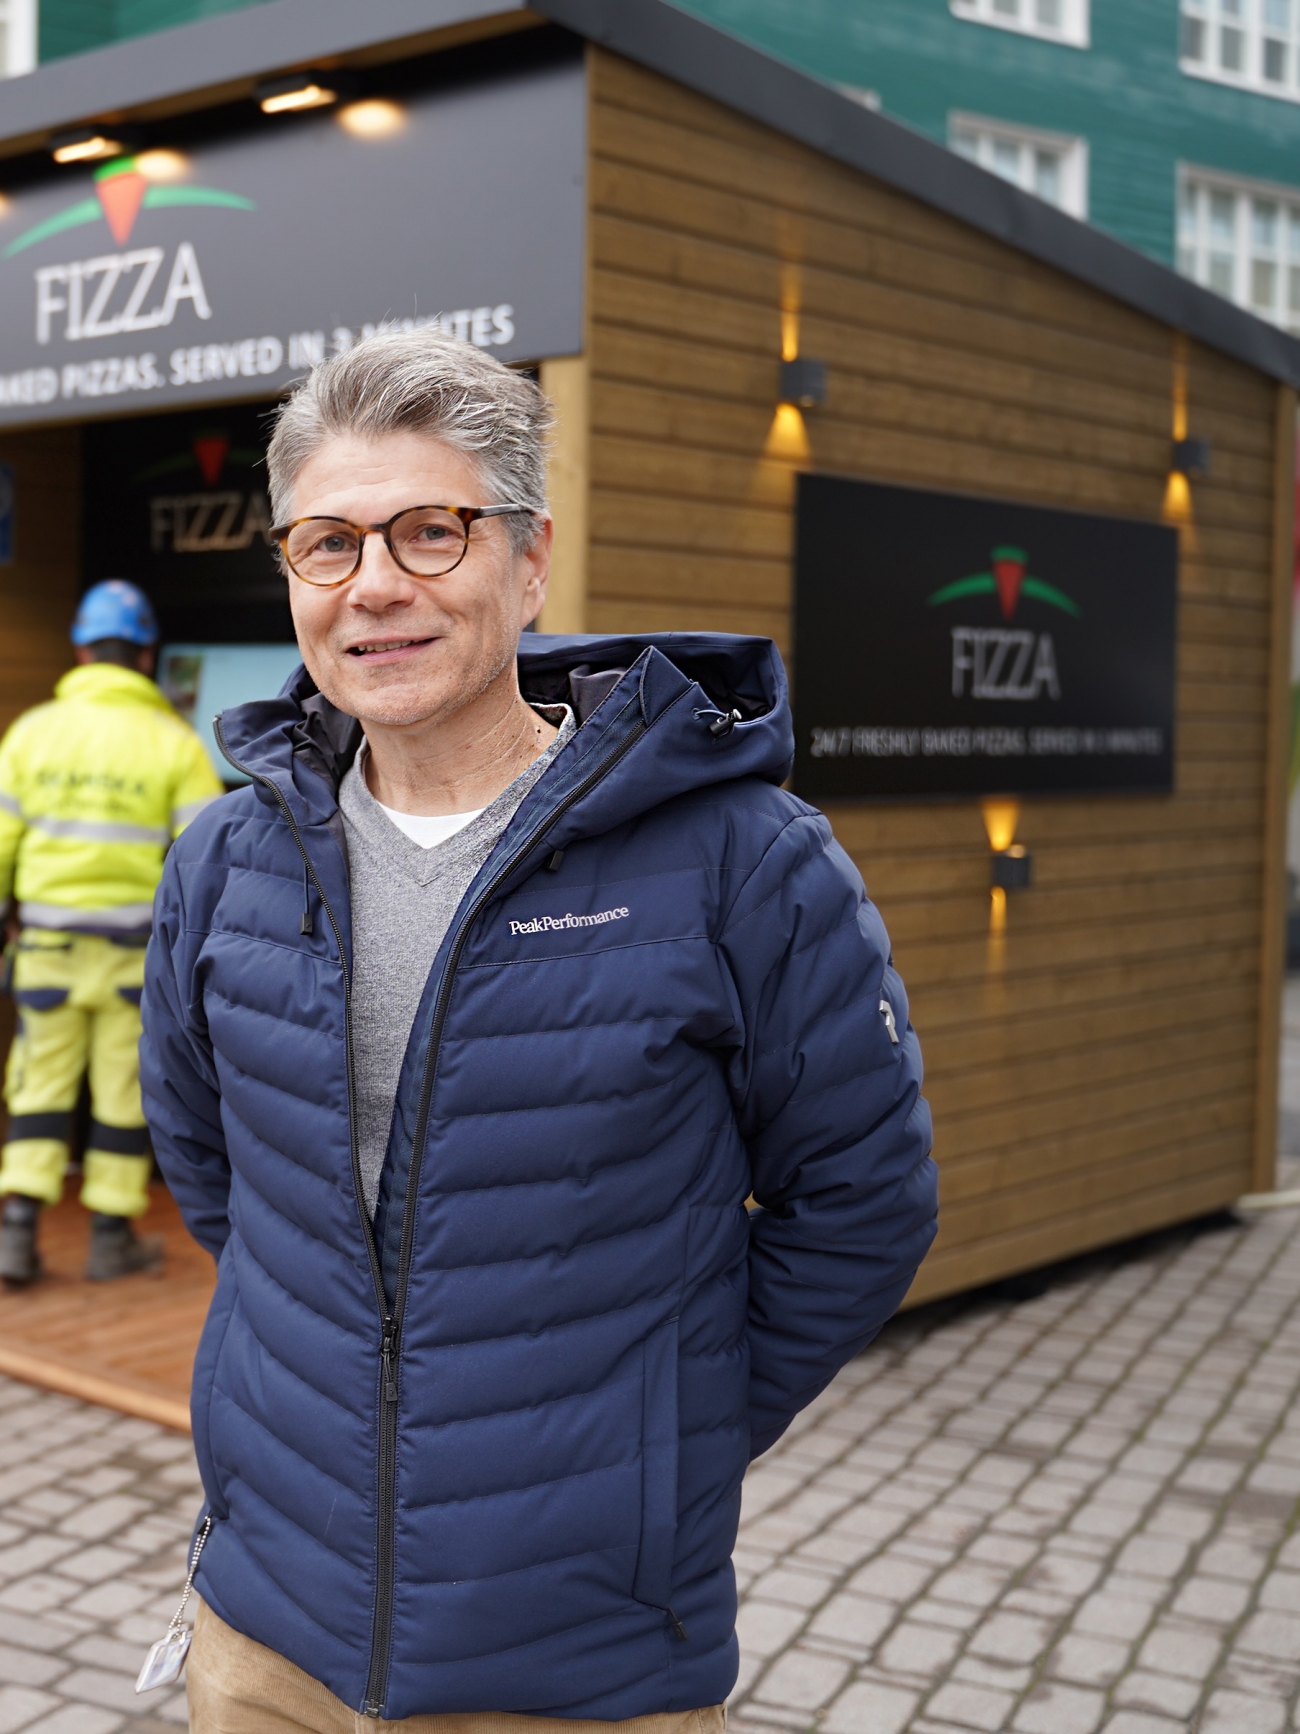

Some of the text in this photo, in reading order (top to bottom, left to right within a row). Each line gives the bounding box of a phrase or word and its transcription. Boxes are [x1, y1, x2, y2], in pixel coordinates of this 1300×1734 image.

[34, 241, 212, 345] FIZZA
[61, 352, 166, 399] PIZZAS.
[169, 336, 283, 386] SERVED
[288, 329, 326, 370] IN
[150, 490, 274, 553] FIZZA
[951, 626, 1062, 700] FIZZA
[509, 906, 630, 935] PeakPerformance
